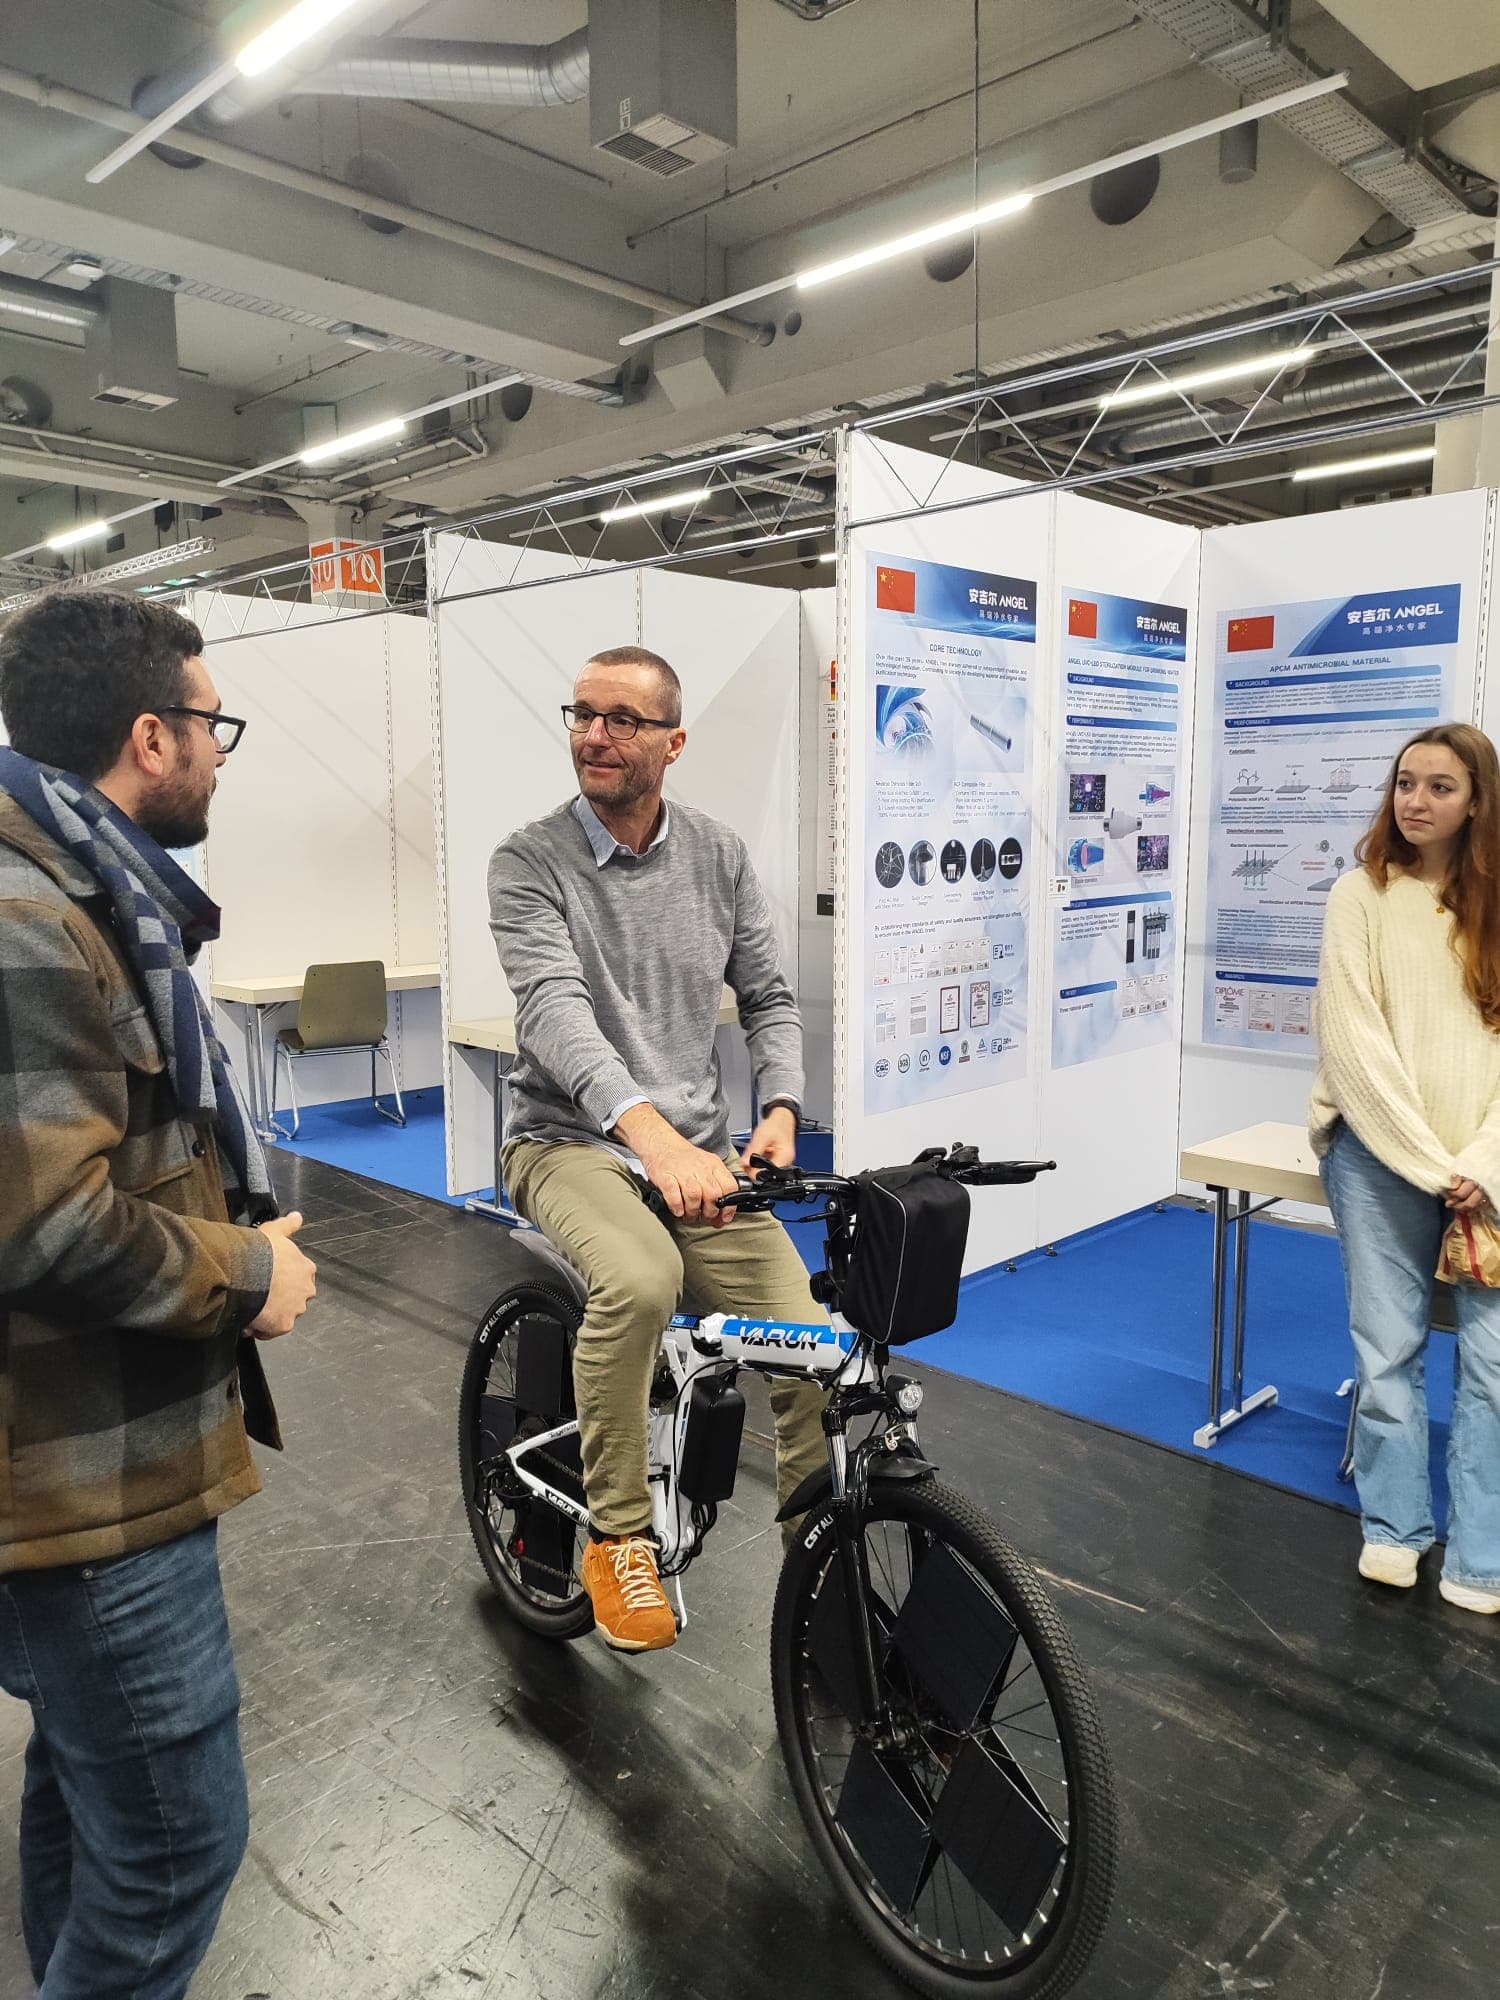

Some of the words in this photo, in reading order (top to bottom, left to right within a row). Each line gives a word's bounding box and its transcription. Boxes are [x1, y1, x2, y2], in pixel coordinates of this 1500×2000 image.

[346, 553, 376, 583] 10
[968, 587, 998, 607] 安吉尔
[999, 594, 1029, 611] ANGEL
[1346, 607, 1391, 625] 安吉尔
[1393, 602, 1444, 619] ANGEL
[1158, 619, 1181, 634] ANGEL
[929, 643, 945, 653] CORE
[946, 645, 983, 657] TECHNOLOGY
[1269, 664, 1291, 673] APCM
[1292, 660, 1350, 671] ANTIMICROBIAL
[1351, 656, 1392, 666] MATERIAL
[479, 1323, 490, 1344] CST
[488, 1313, 499, 1328] ALL
[739, 1325, 822, 1351] VARUN
[548, 1492, 575, 1515] VARUN
[804, 1523, 822, 1550] CST
